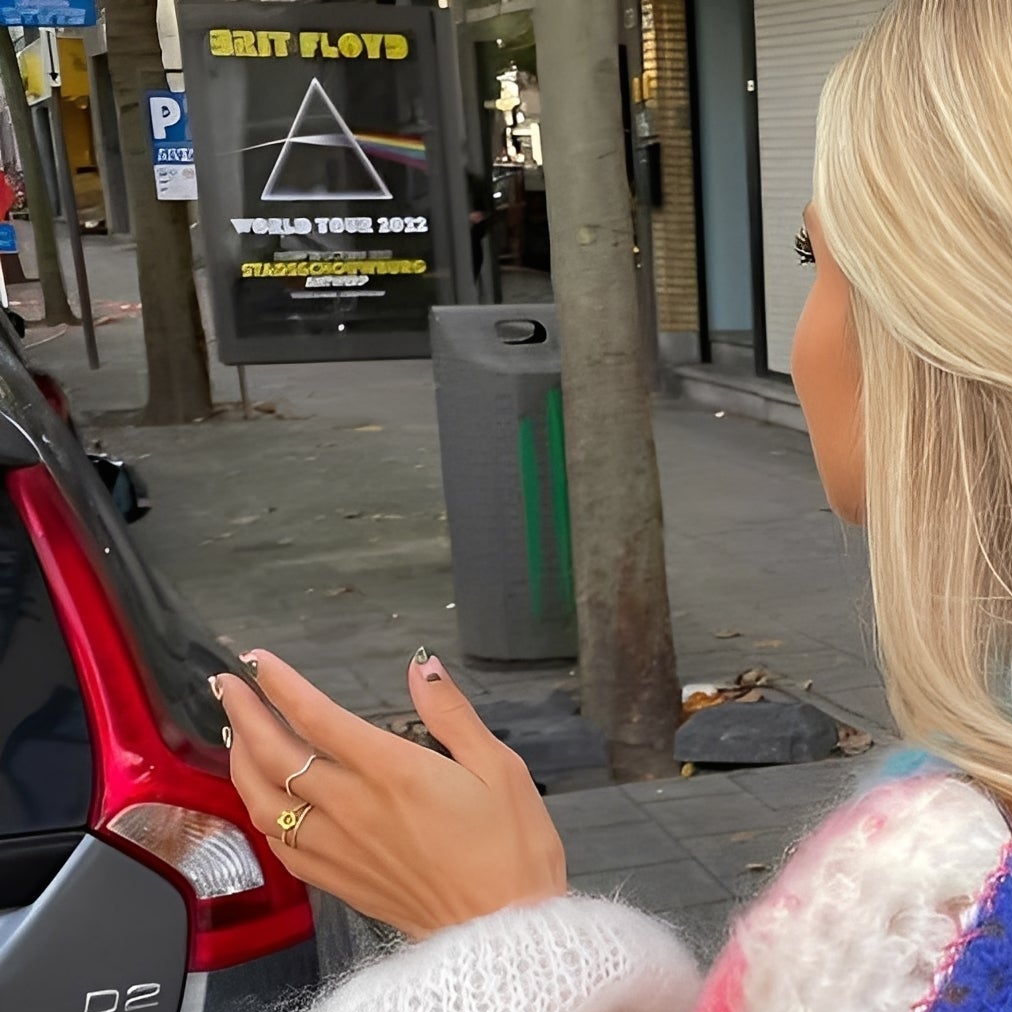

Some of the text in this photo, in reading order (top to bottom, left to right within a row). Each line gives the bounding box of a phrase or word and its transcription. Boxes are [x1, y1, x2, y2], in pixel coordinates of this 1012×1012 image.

[209, 29, 409, 60] BRIT FLOYD
[149, 96, 181, 140] P
[230, 216, 429, 235] WORLD TOUR 2022
